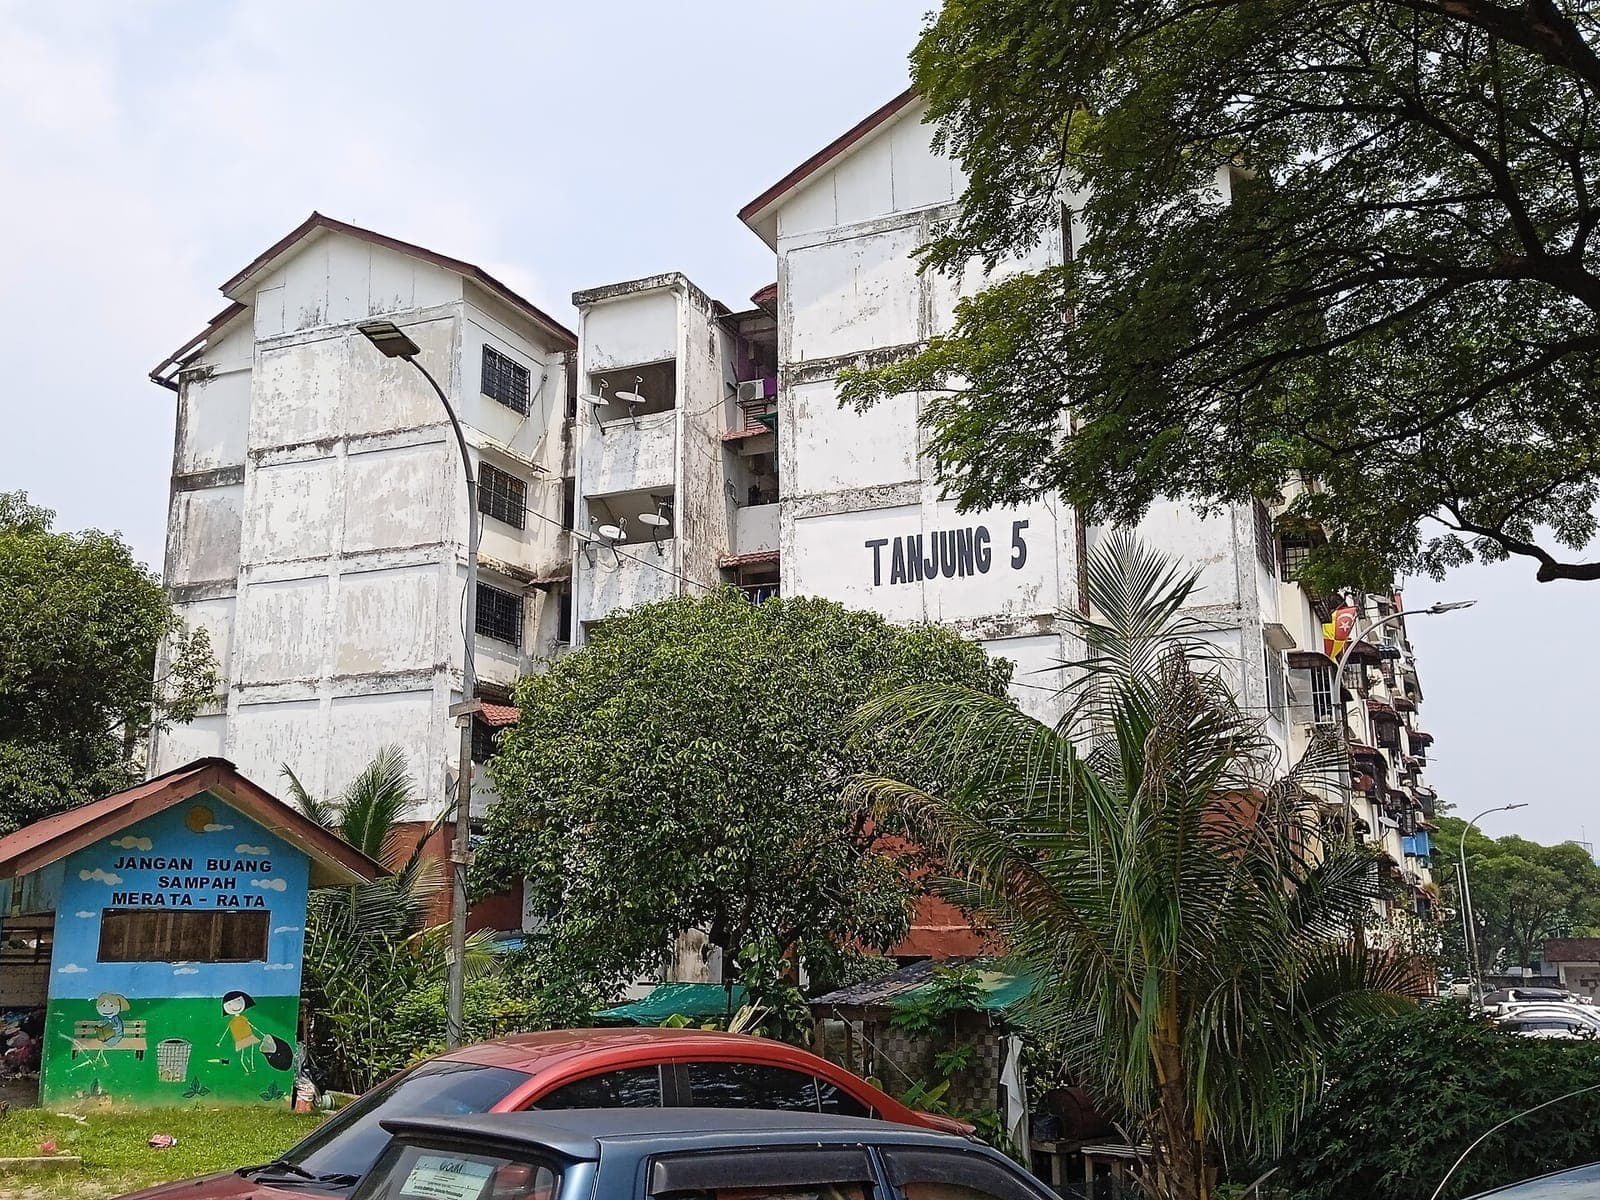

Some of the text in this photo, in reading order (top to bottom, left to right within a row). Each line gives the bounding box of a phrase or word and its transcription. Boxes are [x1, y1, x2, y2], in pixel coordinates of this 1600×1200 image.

[865, 520, 1029, 586] TANJUNG 5
[114, 857, 272, 872] JANGAN BUANG
[158, 876, 236, 889] SAMPAH
[112, 893, 192, 906] MERATA
[217, 895, 265, 907] RATA
